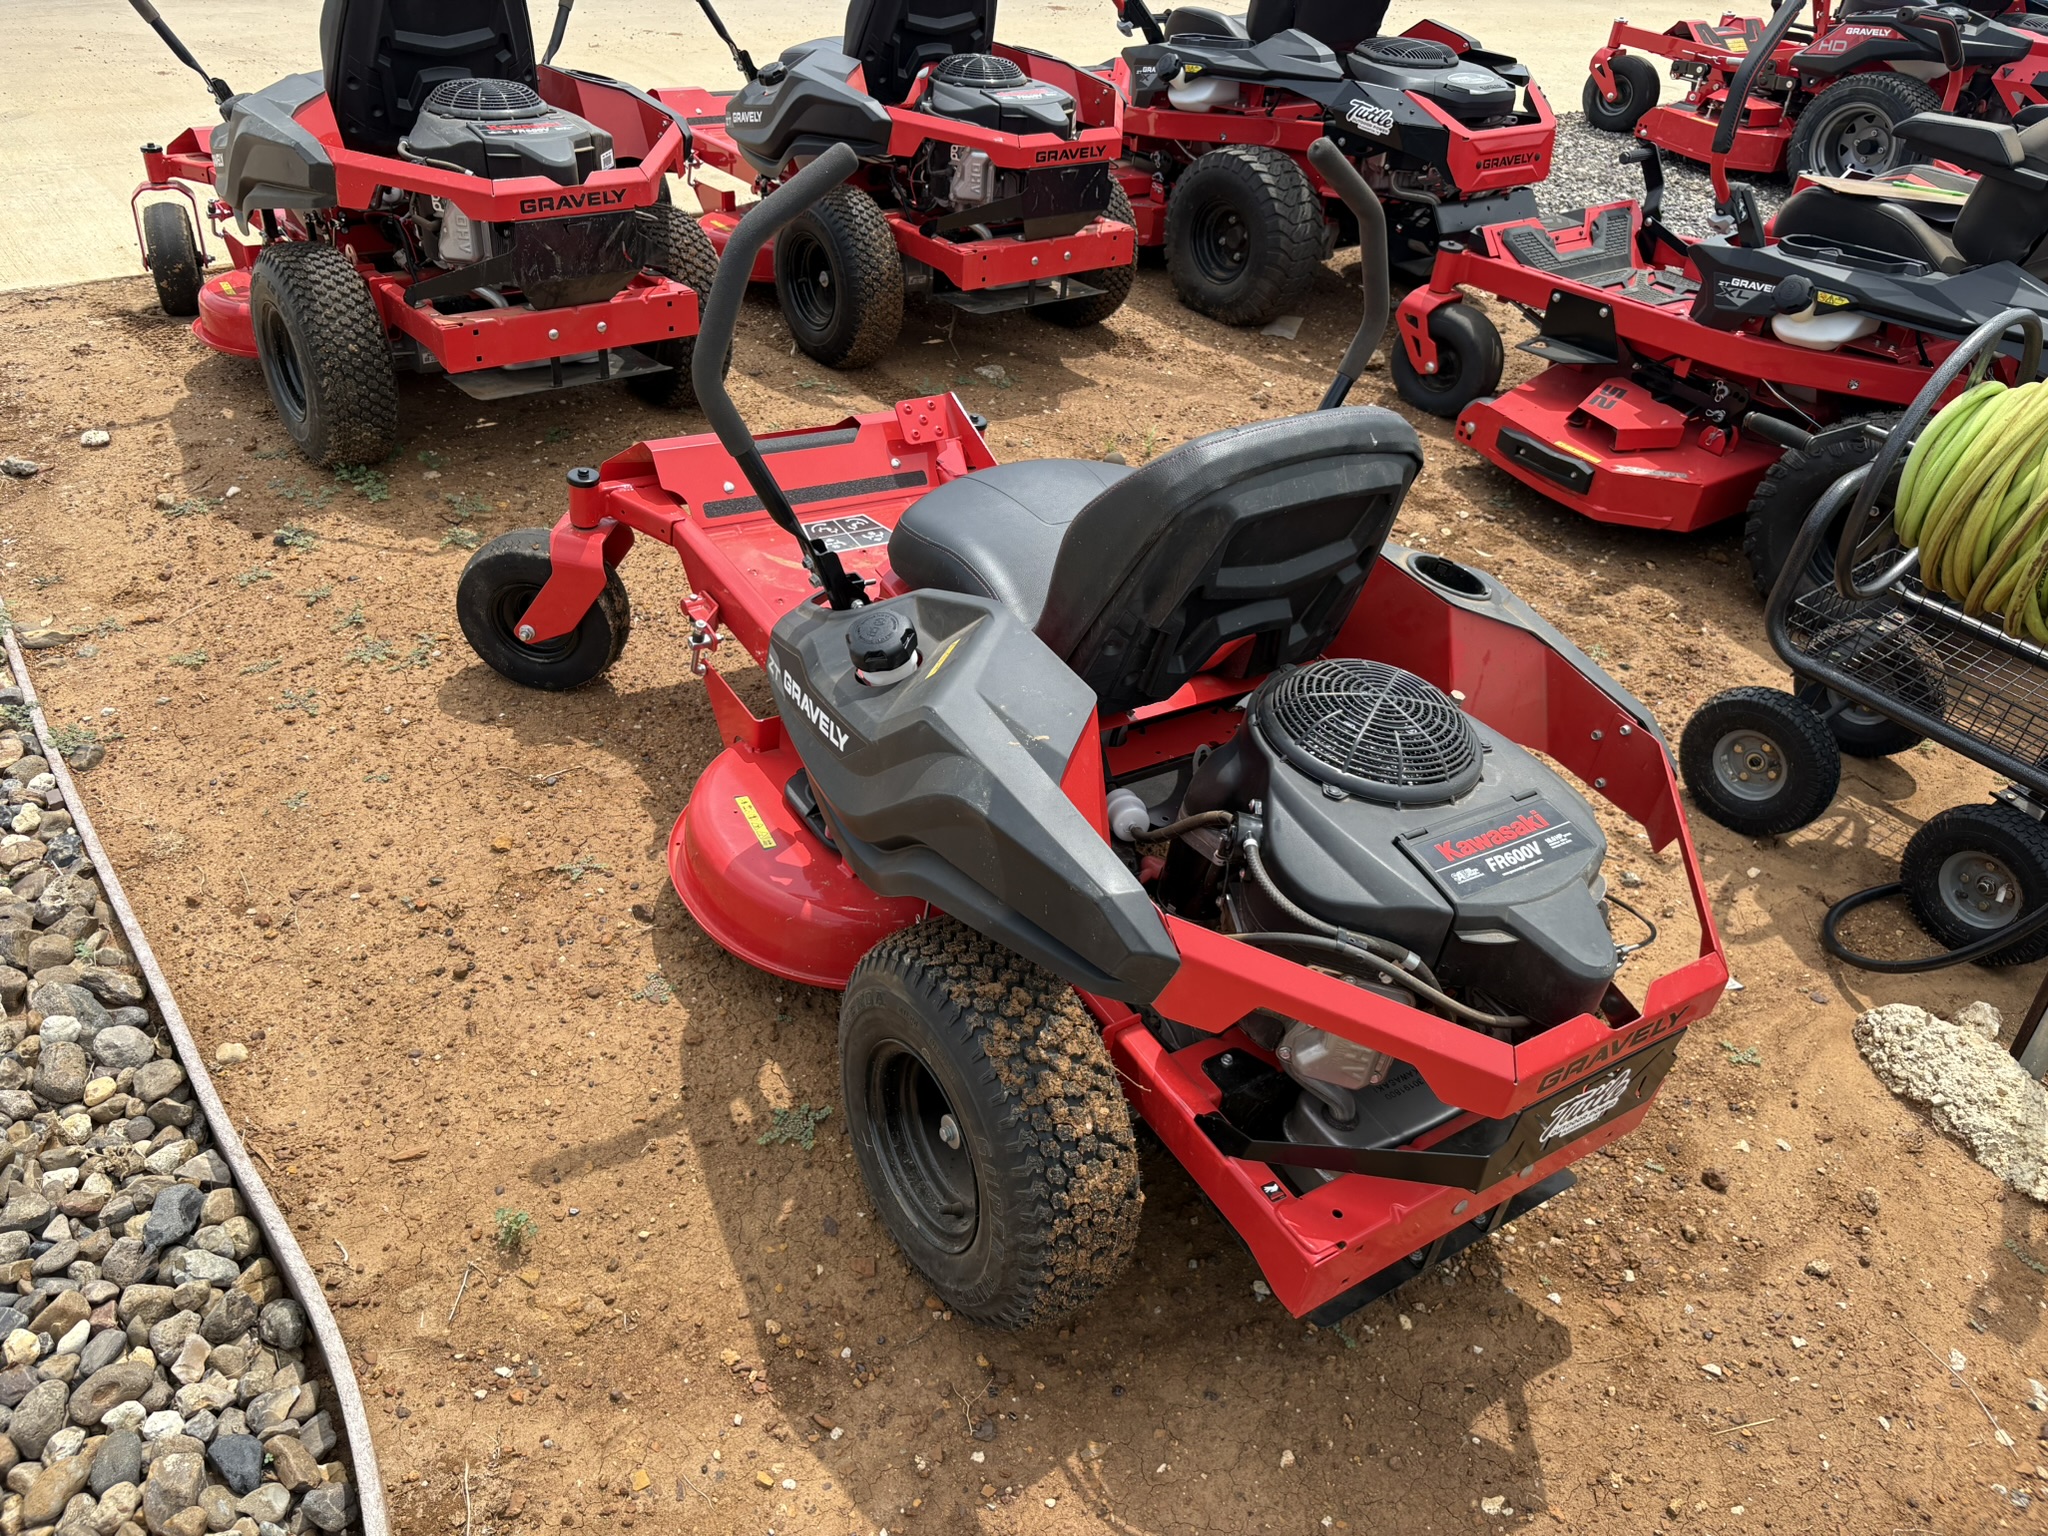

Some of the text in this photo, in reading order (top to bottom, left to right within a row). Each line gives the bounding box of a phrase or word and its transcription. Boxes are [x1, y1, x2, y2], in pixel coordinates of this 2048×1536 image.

[1846, 27, 1891, 37] GRAVELY
[1819, 39, 1847, 52] HD
[732, 111, 763, 123] GRAVELY
[1346, 99, 1393, 128] Tuttle
[1036, 145, 1107, 163] GRAVELY
[1483, 152, 1535, 169] GRAVELY
[519, 188, 627, 215] GRAVELY
[1719, 287, 1751, 300] XL
[1731, 278, 1775, 293] GRAVE
[1589, 384, 1628, 410] 52
[768, 653, 849, 752] ZT GRAVELY
[1434, 810, 1550, 862] Kawasaki
[1485, 841, 1542, 872] FR600V
[1537, 1005, 1690, 1095] GRAVELY
[1539, 1068, 1631, 1143] Tuttle
